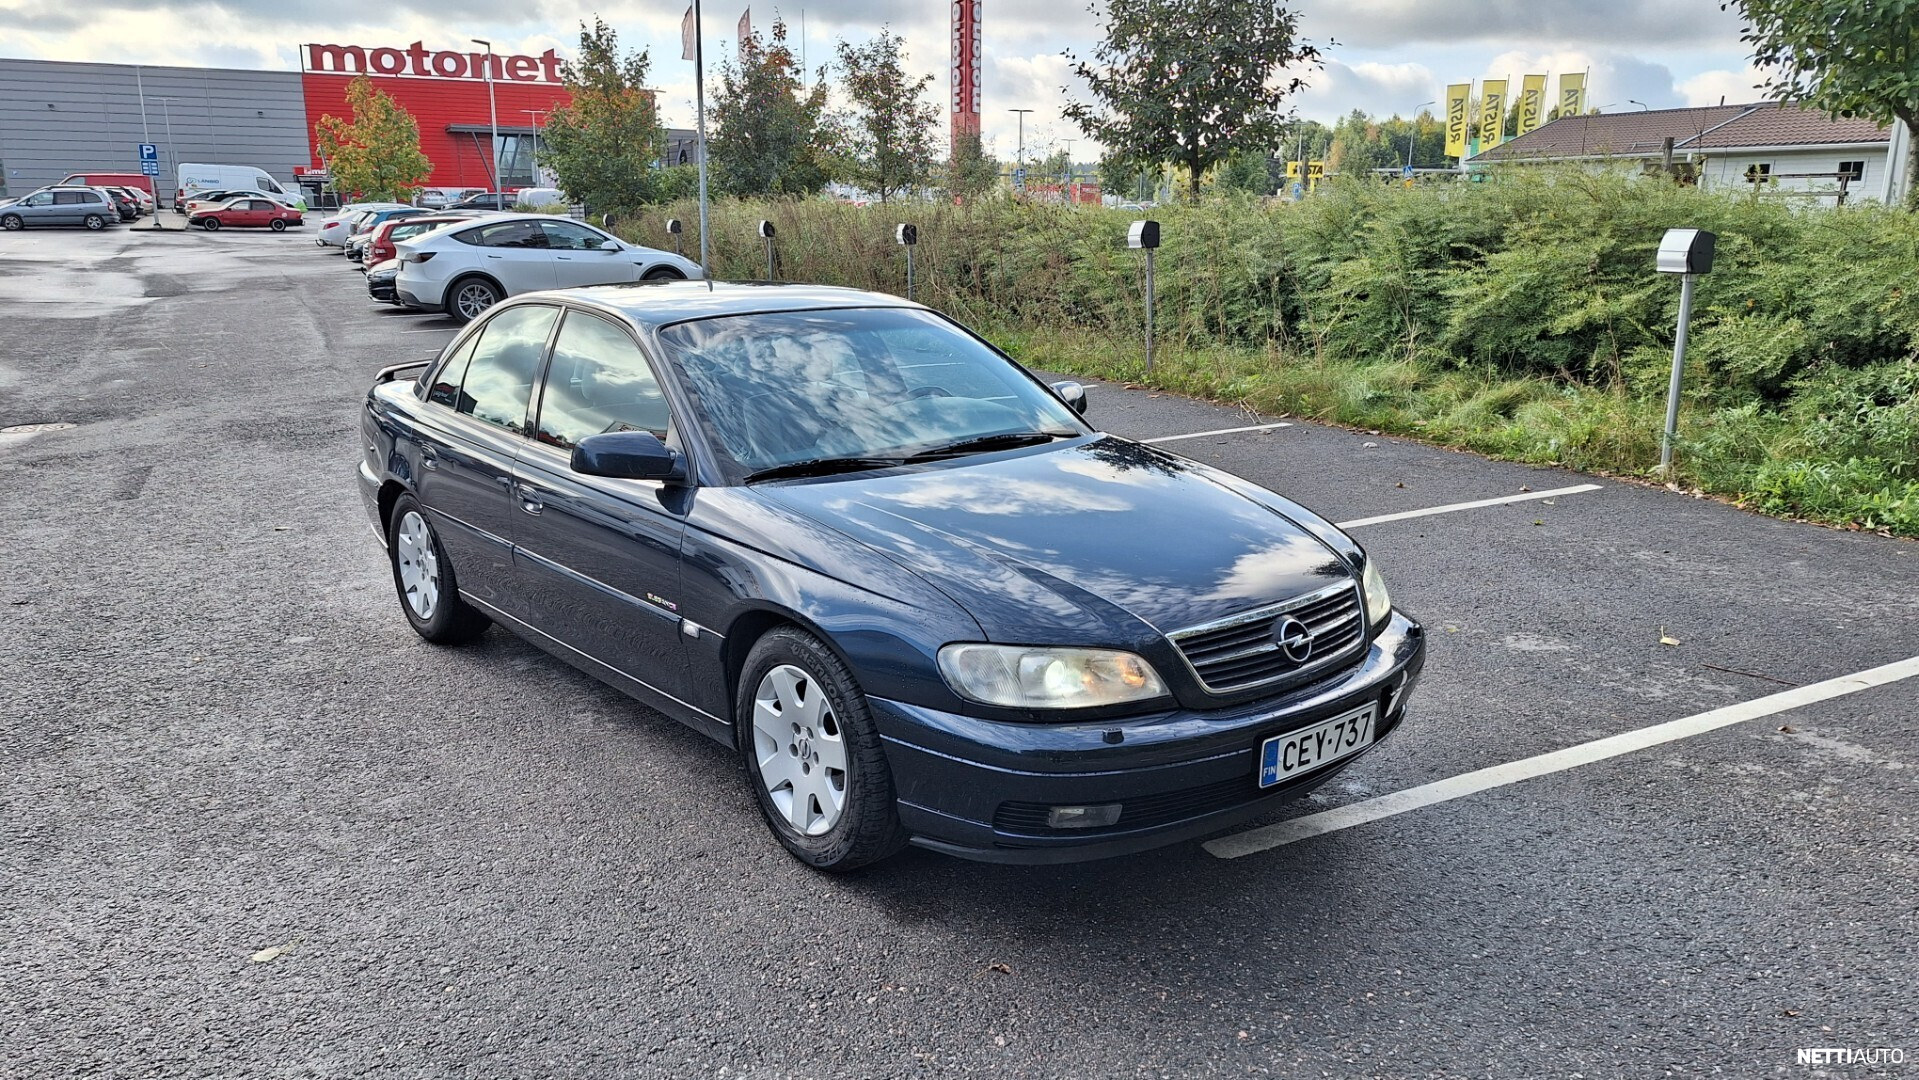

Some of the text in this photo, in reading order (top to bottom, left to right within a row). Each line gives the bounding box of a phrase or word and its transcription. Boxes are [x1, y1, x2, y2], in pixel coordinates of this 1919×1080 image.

[309, 40, 563, 83] motonet
[142, 145, 154, 159] P
[1282, 711, 1372, 772] CEY-737
[1263, 765, 1277, 777] FIN
